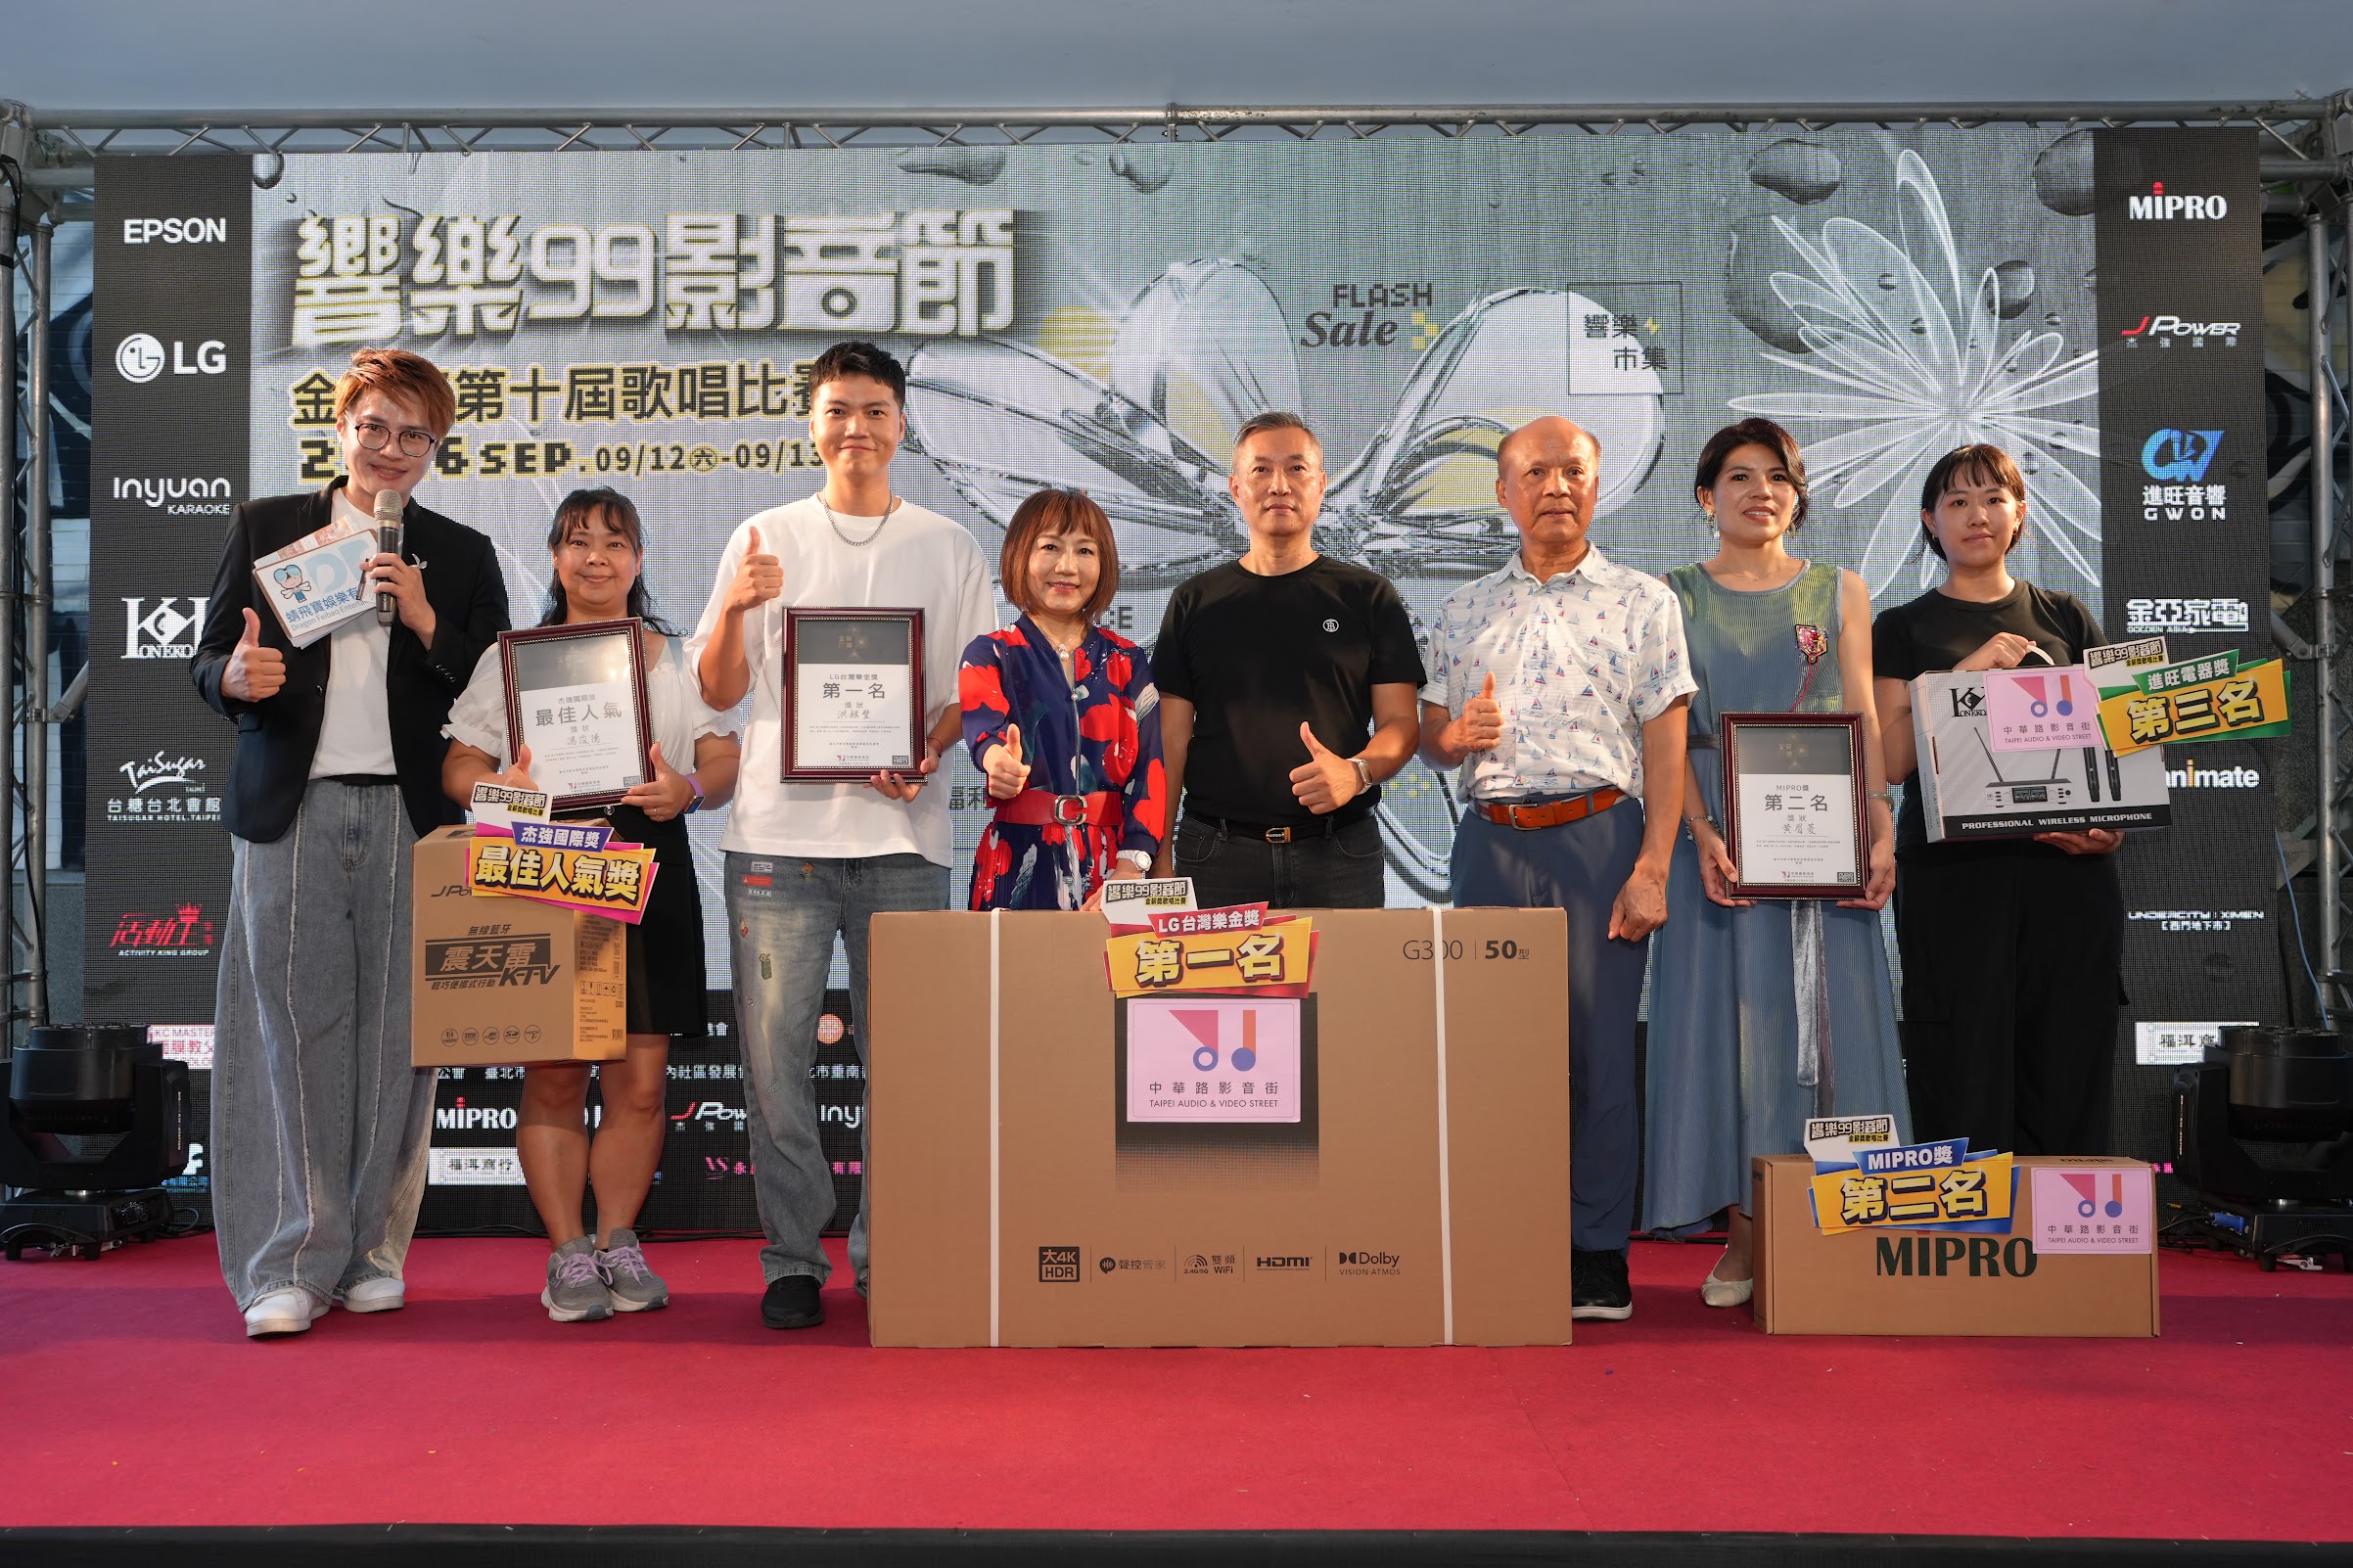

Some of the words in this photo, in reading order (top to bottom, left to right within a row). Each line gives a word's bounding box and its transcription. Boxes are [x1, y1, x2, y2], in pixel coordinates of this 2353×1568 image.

[2129, 182, 2227, 221] MIPRO
[123, 218, 226, 244] EPSON
[293, 209, 1014, 346] 響樂99影音節
[1333, 284, 1433, 307] FLASH
[1301, 312, 1398, 348] Sale
[1584, 314, 1638, 339] 響樂
[173, 341, 226, 375] LG
[1614, 346, 1667, 371] 市集
[2143, 485, 2227, 506] 進旺音響
[167, 504, 230, 515] KARAOKE
[2145, 508, 2226, 521] GWON
[291, 616, 315, 631] Dragon
[316, 608, 340, 622] Feibao
[2126, 598, 2243, 626] 金亞家電
[2088, 639, 2164, 670] 響樂99影音節
[2147, 659, 2232, 691] 進旺電器獎
[823, 682, 885, 699] 第一名
[535, 702, 622, 726] 最佳人氣
[2126, 679, 2265, 744] 第三名
[2004, 722, 2090, 734] 中華路影音街
[119, 750, 207, 788] TaiSugar
[108, 798, 220, 812] 台糖台北會館
[474, 786, 547, 808] 響樂99影音節
[1765, 794, 1827, 812] 第二名
[1961, 818, 2034, 830] PROFESSIONAL
[2039, 816, 2086, 826] WIRELESS
[2090, 812, 2152, 823] MICROPHONE
[521, 826, 600, 849] 杰強國際獎
[476, 847, 640, 905] 最佳人氣獎
[1106, 881, 1187, 902] 響樂99影音節
[1158, 909, 1260, 933] LG台灣樂金獎
[2220, 910, 2265, 919] XIMEN
[468, 924, 511, 937] 無線藍牙
[440, 943, 535, 972] 震天雷
[1134, 934, 1284, 988] 第一名
[431, 980, 495, 991] 輕巧便攜式行動
[499, 965, 561, 987] KTV
[1149, 1082, 1278, 1094] 中華路影音街
[437, 1096, 518, 1129] MIPRO
[821, 1104, 864, 1129] Iny
[1810, 1117, 1890, 1139] 響樂99影音節
[1868, 1144, 1954, 1171] MIPRO獎
[1841, 1170, 1987, 1223] 第二名
[2048, 1224, 2139, 1234] 中華路影音街
[1042, 1249, 1077, 1264] 大4K
[1119, 1260, 1166, 1269] 聲控管家
[1212, 1255, 1235, 1265] 雙頻
[1257, 1257, 1310, 1267] HDMI
[1360, 1252, 1400, 1267] Dolby
[1876, 1235, 2038, 1277] MIPRO
[1045, 1267, 1074, 1278] HDR
[1214, 1266, 1233, 1274] WiFi
